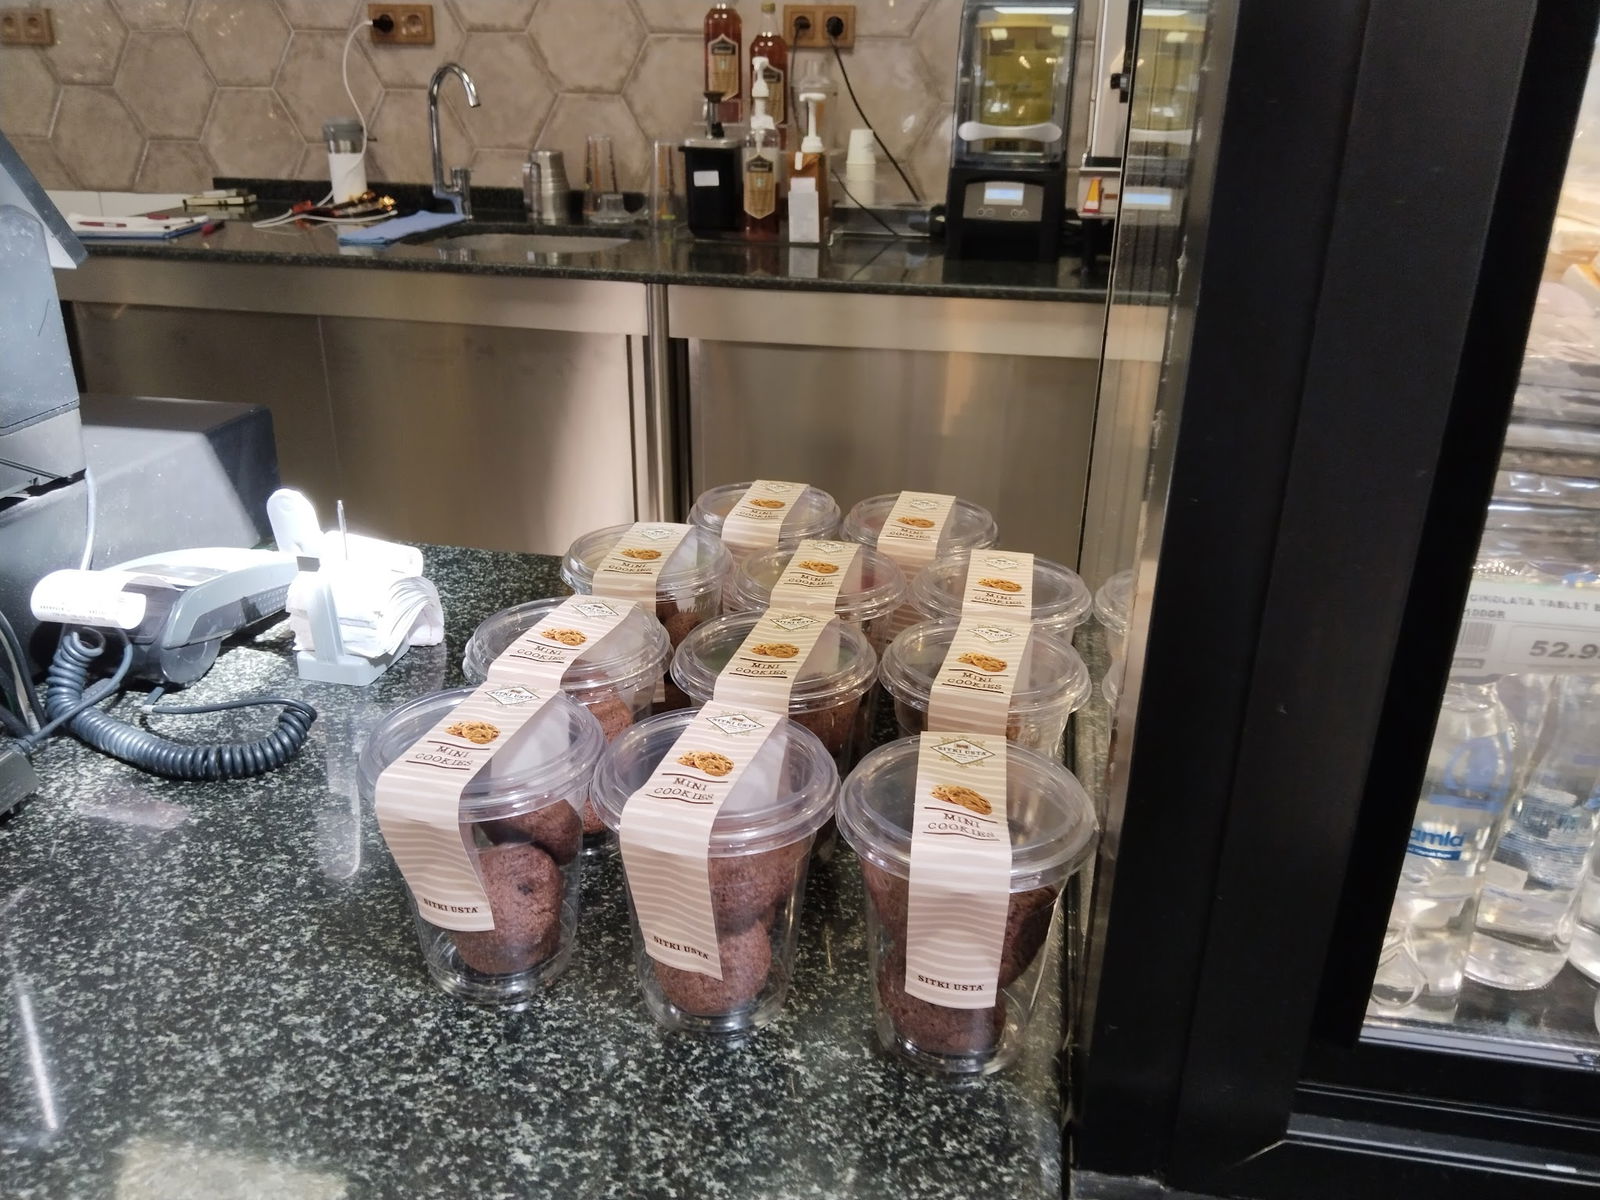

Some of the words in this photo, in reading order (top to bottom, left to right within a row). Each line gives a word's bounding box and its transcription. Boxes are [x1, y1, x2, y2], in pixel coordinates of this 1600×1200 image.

[534, 645, 562, 655] MINI
[1529, 640, 1600, 660] 52.9
[735, 666, 788, 675] COOKIES
[962, 672, 993, 682] MINI
[947, 678, 1003, 689] COOKIES
[436, 745, 469, 758] MINI
[415, 753, 473, 767] COOKIES
[672, 777, 708, 791] MINI
[654, 787, 714, 801] COOKIES
[943, 812, 981, 829] MINI
[927, 822, 995, 838] COOKIES
[423, 898, 449, 911] SITKI
[450, 906, 478, 914] USTA
[653, 935, 681, 951] SITKI
[683, 946, 709, 960] USTA
[918, 975, 950, 989] SITKI
[954, 984, 983, 992] USTA
